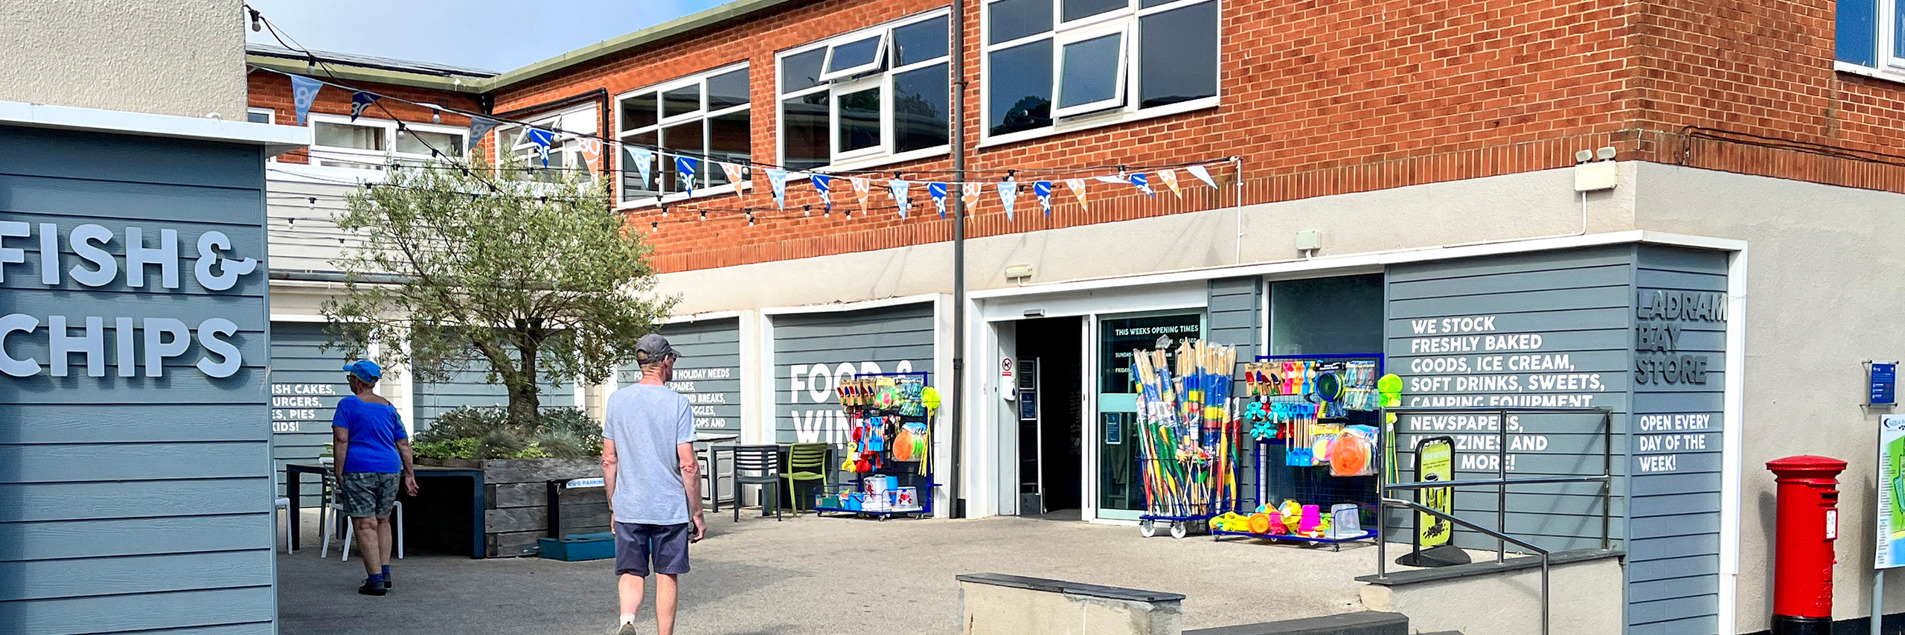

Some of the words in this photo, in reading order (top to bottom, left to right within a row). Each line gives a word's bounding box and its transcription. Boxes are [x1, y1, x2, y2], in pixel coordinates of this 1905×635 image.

[0, 221, 179, 288] FISH
[195, 231, 258, 291] &
[1637, 290, 1728, 321] LADRAM
[1115, 328, 1129, 336] THIS
[1130, 327, 1151, 335] WEEKS
[1151, 325, 1179, 334] OPENING
[1411, 318, 1437, 334] WE
[1441, 316, 1496, 333] STOCK
[0, 313, 242, 379] CHIPS
[1411, 336, 1480, 353] FRESHLY
[1485, 334, 1543, 351] BAKED
[1637, 322, 1681, 353] BAY
[1411, 357, 1472, 374] GOODS,
[1476, 355, 1503, 371] ICE
[1508, 354, 1575, 372] CREAM,
[1636, 354, 1707, 385] STORE
[678, 369, 707, 380] HOLIDAY
[707, 368, 730, 378] NEEDS
[271, 384, 291, 395] ISH
[294, 384, 336, 396] CAKES,
[670, 382, 696, 392] SPADES,
[1410, 377, 1452, 392] SOFT
[1456, 375, 1523, 393] DRINKS,
[1528, 374, 1605, 392] SWEETS,
[272, 397, 323, 408] URGERS,
[697, 393, 726, 404] BREAKS,
[1410, 396, 1484, 407] CAMPING
[1489, 394, 1595, 407] EQUIPMENT
[289, 409, 315, 419] PIES
[691, 405, 716, 417] OGGLES,
[710, 418, 726, 428] AND
[791, 409, 850, 450] WIN
[1640, 415, 1672, 431] OPEN
[1674, 414, 1710, 430] EVERY
[1510, 435, 1548, 451] AND
[1639, 435, 1662, 452] DAY
[1665, 434, 1681, 450] OF
[1683, 434, 1706, 450] THE
[1639, 454, 1676, 472] WEEK!
